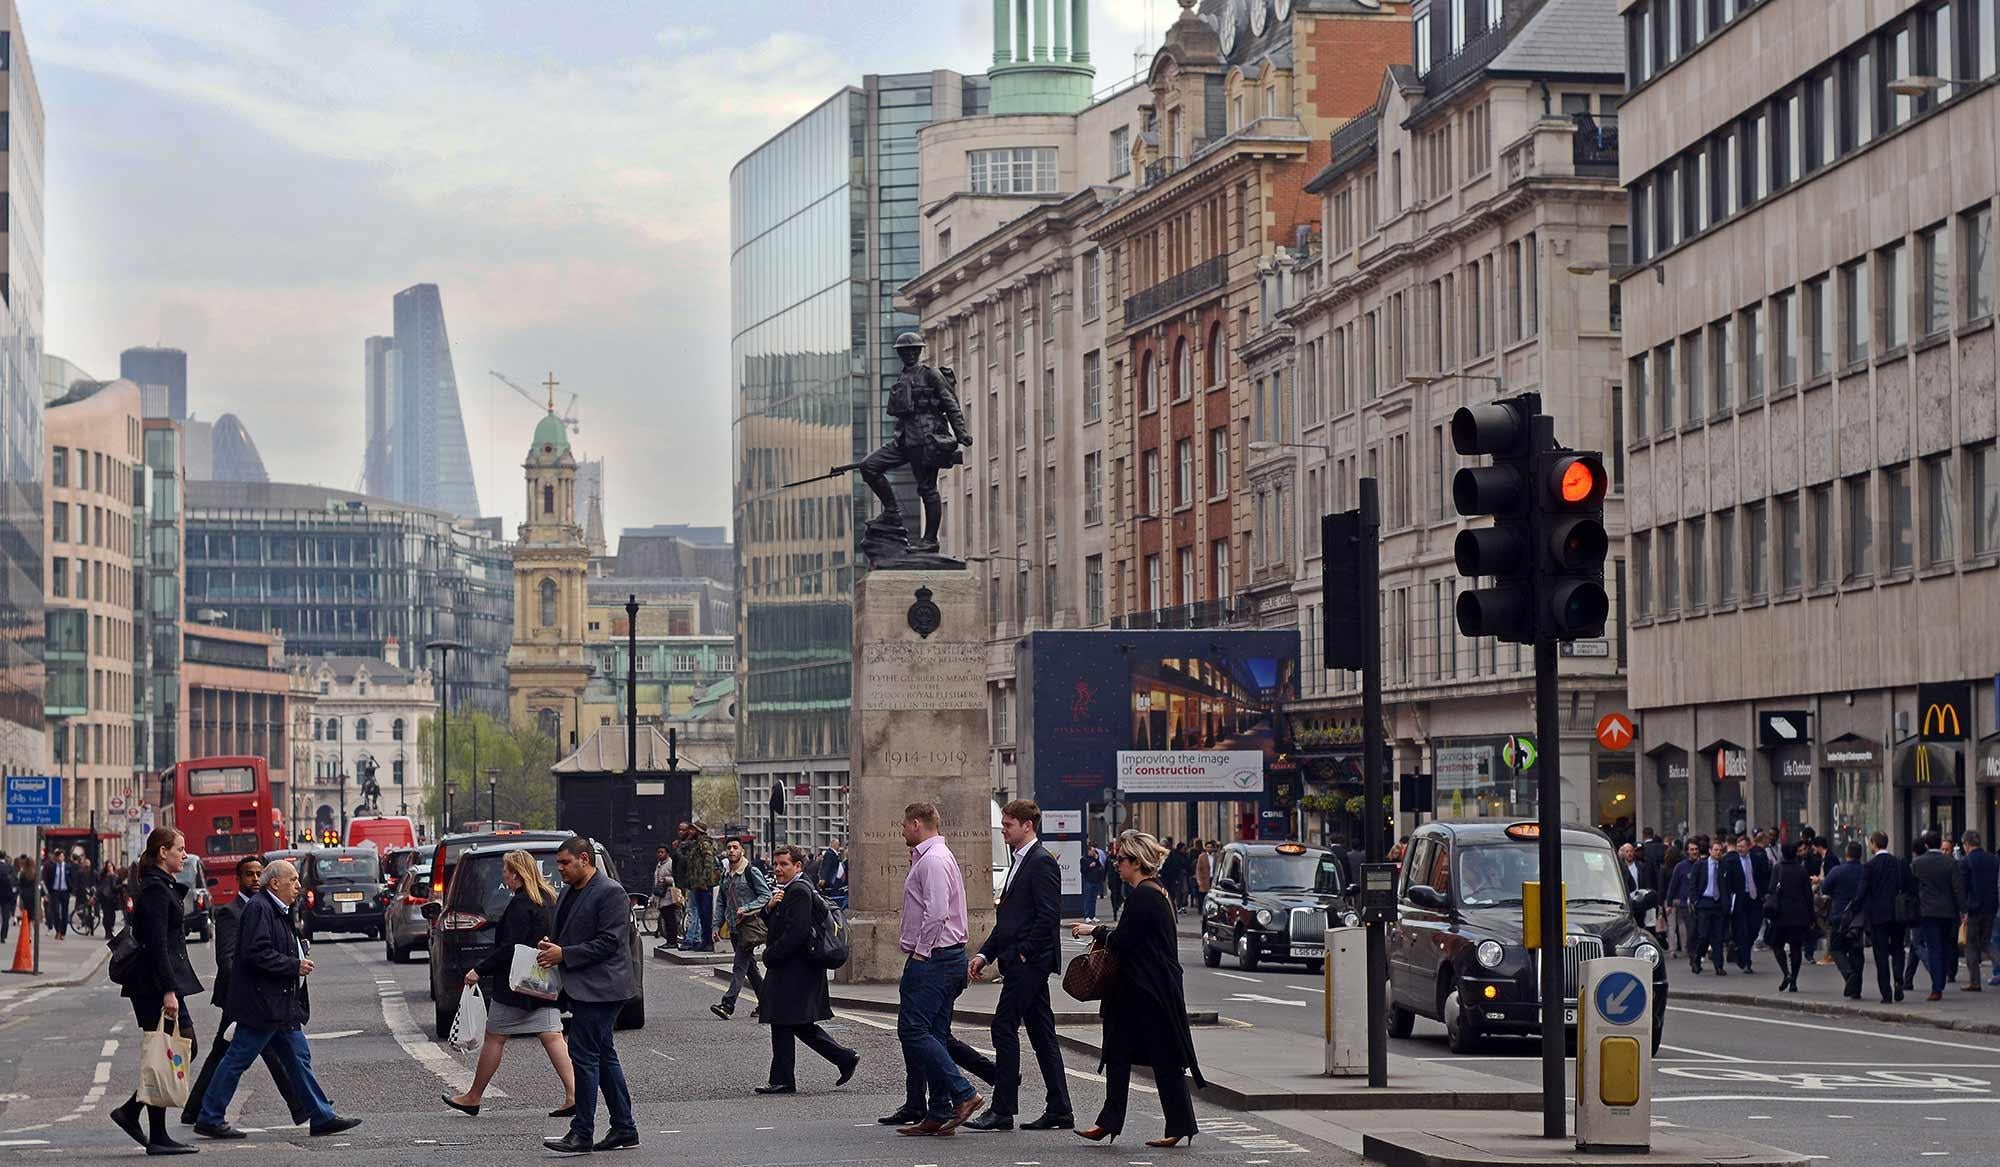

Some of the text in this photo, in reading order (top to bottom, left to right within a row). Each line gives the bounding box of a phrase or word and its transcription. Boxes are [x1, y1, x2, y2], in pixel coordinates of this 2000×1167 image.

[885, 752, 967, 765] 1914-1919
[1122, 754, 1230, 766] Improving the image
[1122, 766, 1205, 775] of construction
